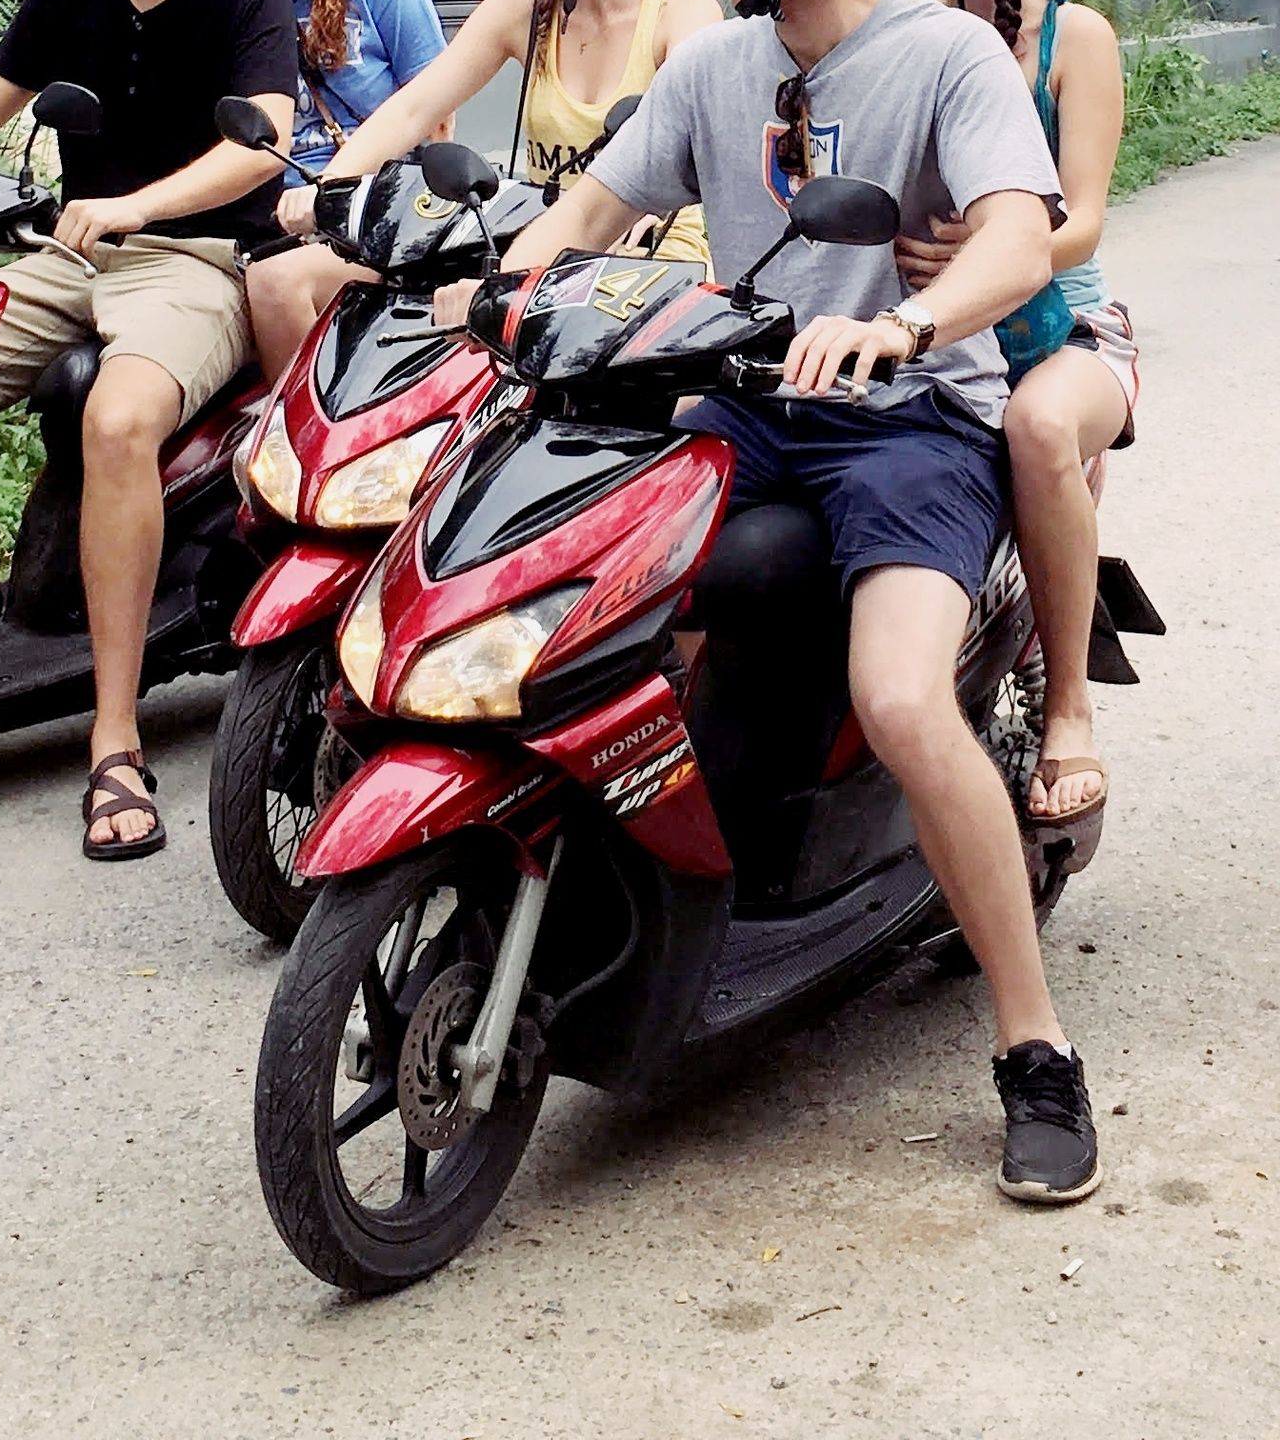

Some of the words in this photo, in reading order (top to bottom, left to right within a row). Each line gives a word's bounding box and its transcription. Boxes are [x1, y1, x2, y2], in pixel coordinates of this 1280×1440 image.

[593, 263, 670, 322] 4
[590, 714, 671, 769] HONDA
[603, 740, 692, 802] Tune
